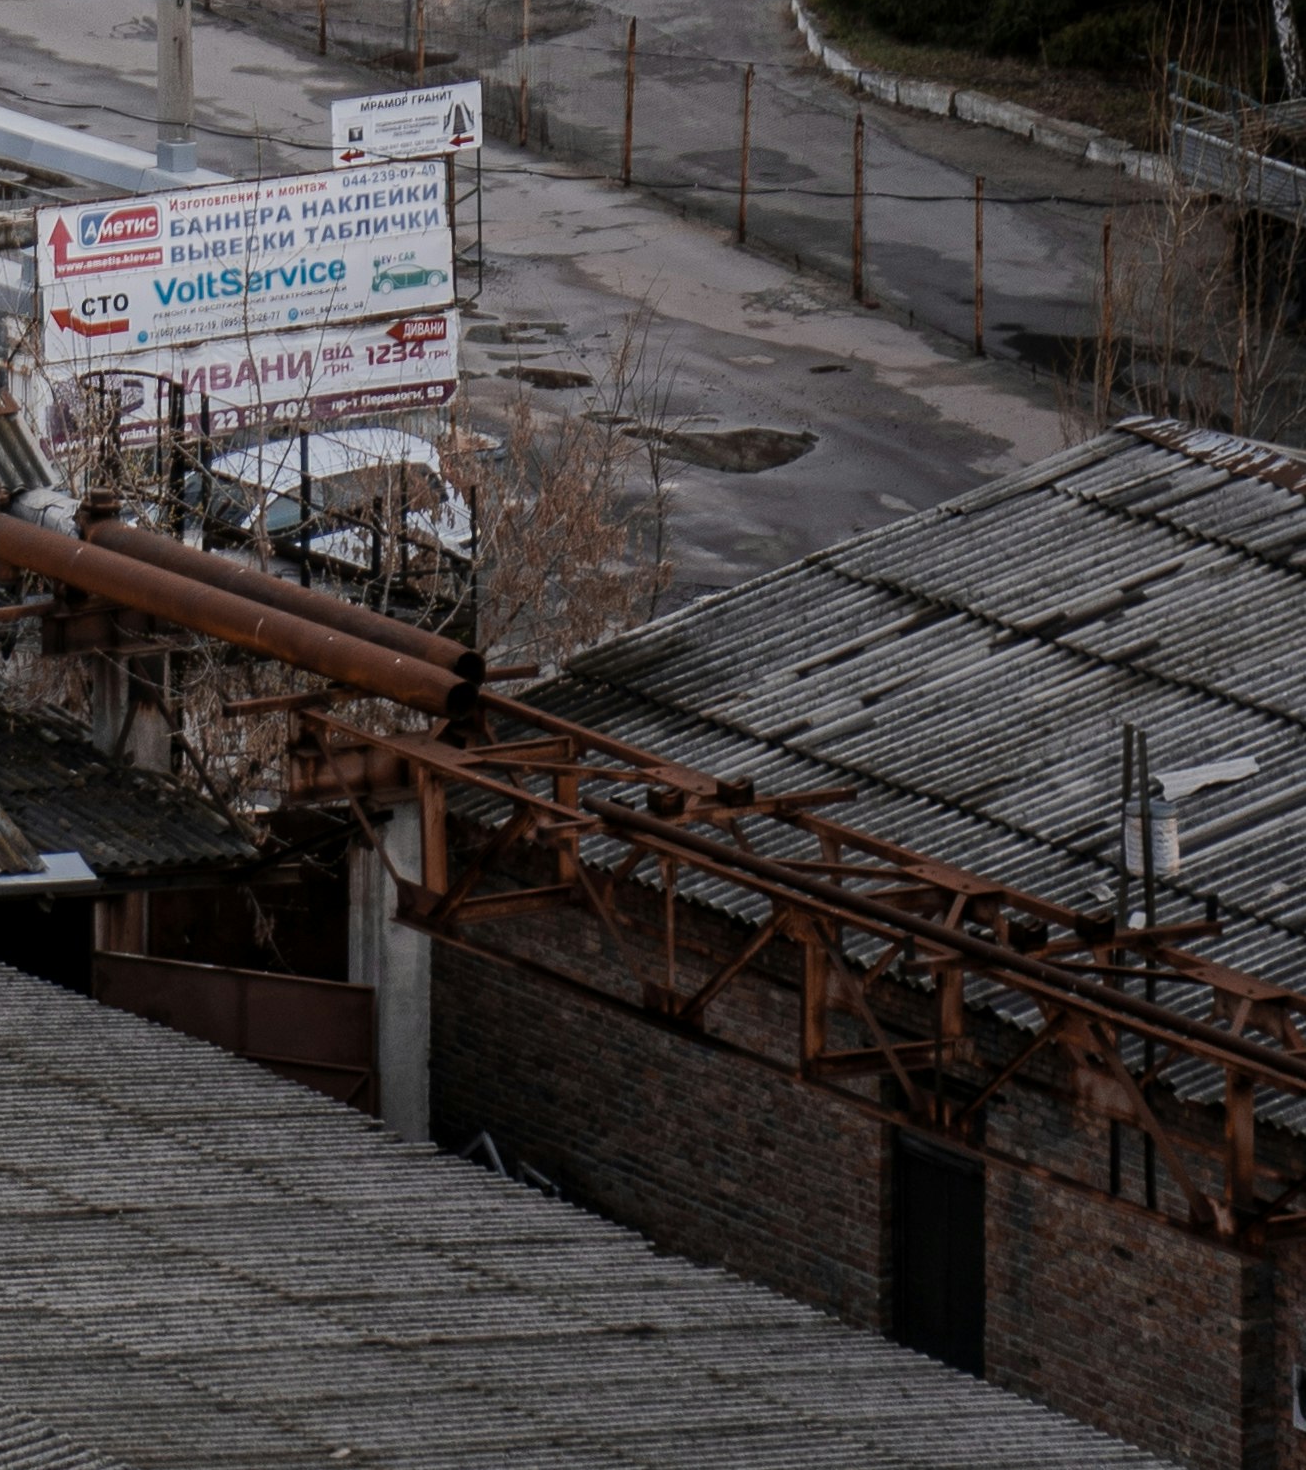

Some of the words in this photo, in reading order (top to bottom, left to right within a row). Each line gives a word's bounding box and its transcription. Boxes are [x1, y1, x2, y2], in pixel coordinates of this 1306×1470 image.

[360, 96, 408, 111] МРАМОР
[411, 89, 453, 105] ГРАНИТ
[342, 164, 436, 188] 044-239-07-40
[169, 191, 262, 212] Изготовление
[266, 189, 274, 199] и
[278, 181, 328, 196] монтаж
[170, 207, 291, 237] БАННЕРА
[302, 182, 439, 219] НАКЛЕЙКИ
[170, 230, 295, 263] ВЫВЕСКИ
[306, 208, 440, 244] ТАБЛИЧКИ
[152, 257, 348, 306] VoltService
[81, 292, 129, 317] СТО
[403, 321, 445, 339] ДИВАНИ
[365, 340, 426, 366] 1234
[323, 362, 354, 377] грн.
[213, 410, 239, 430] 22
